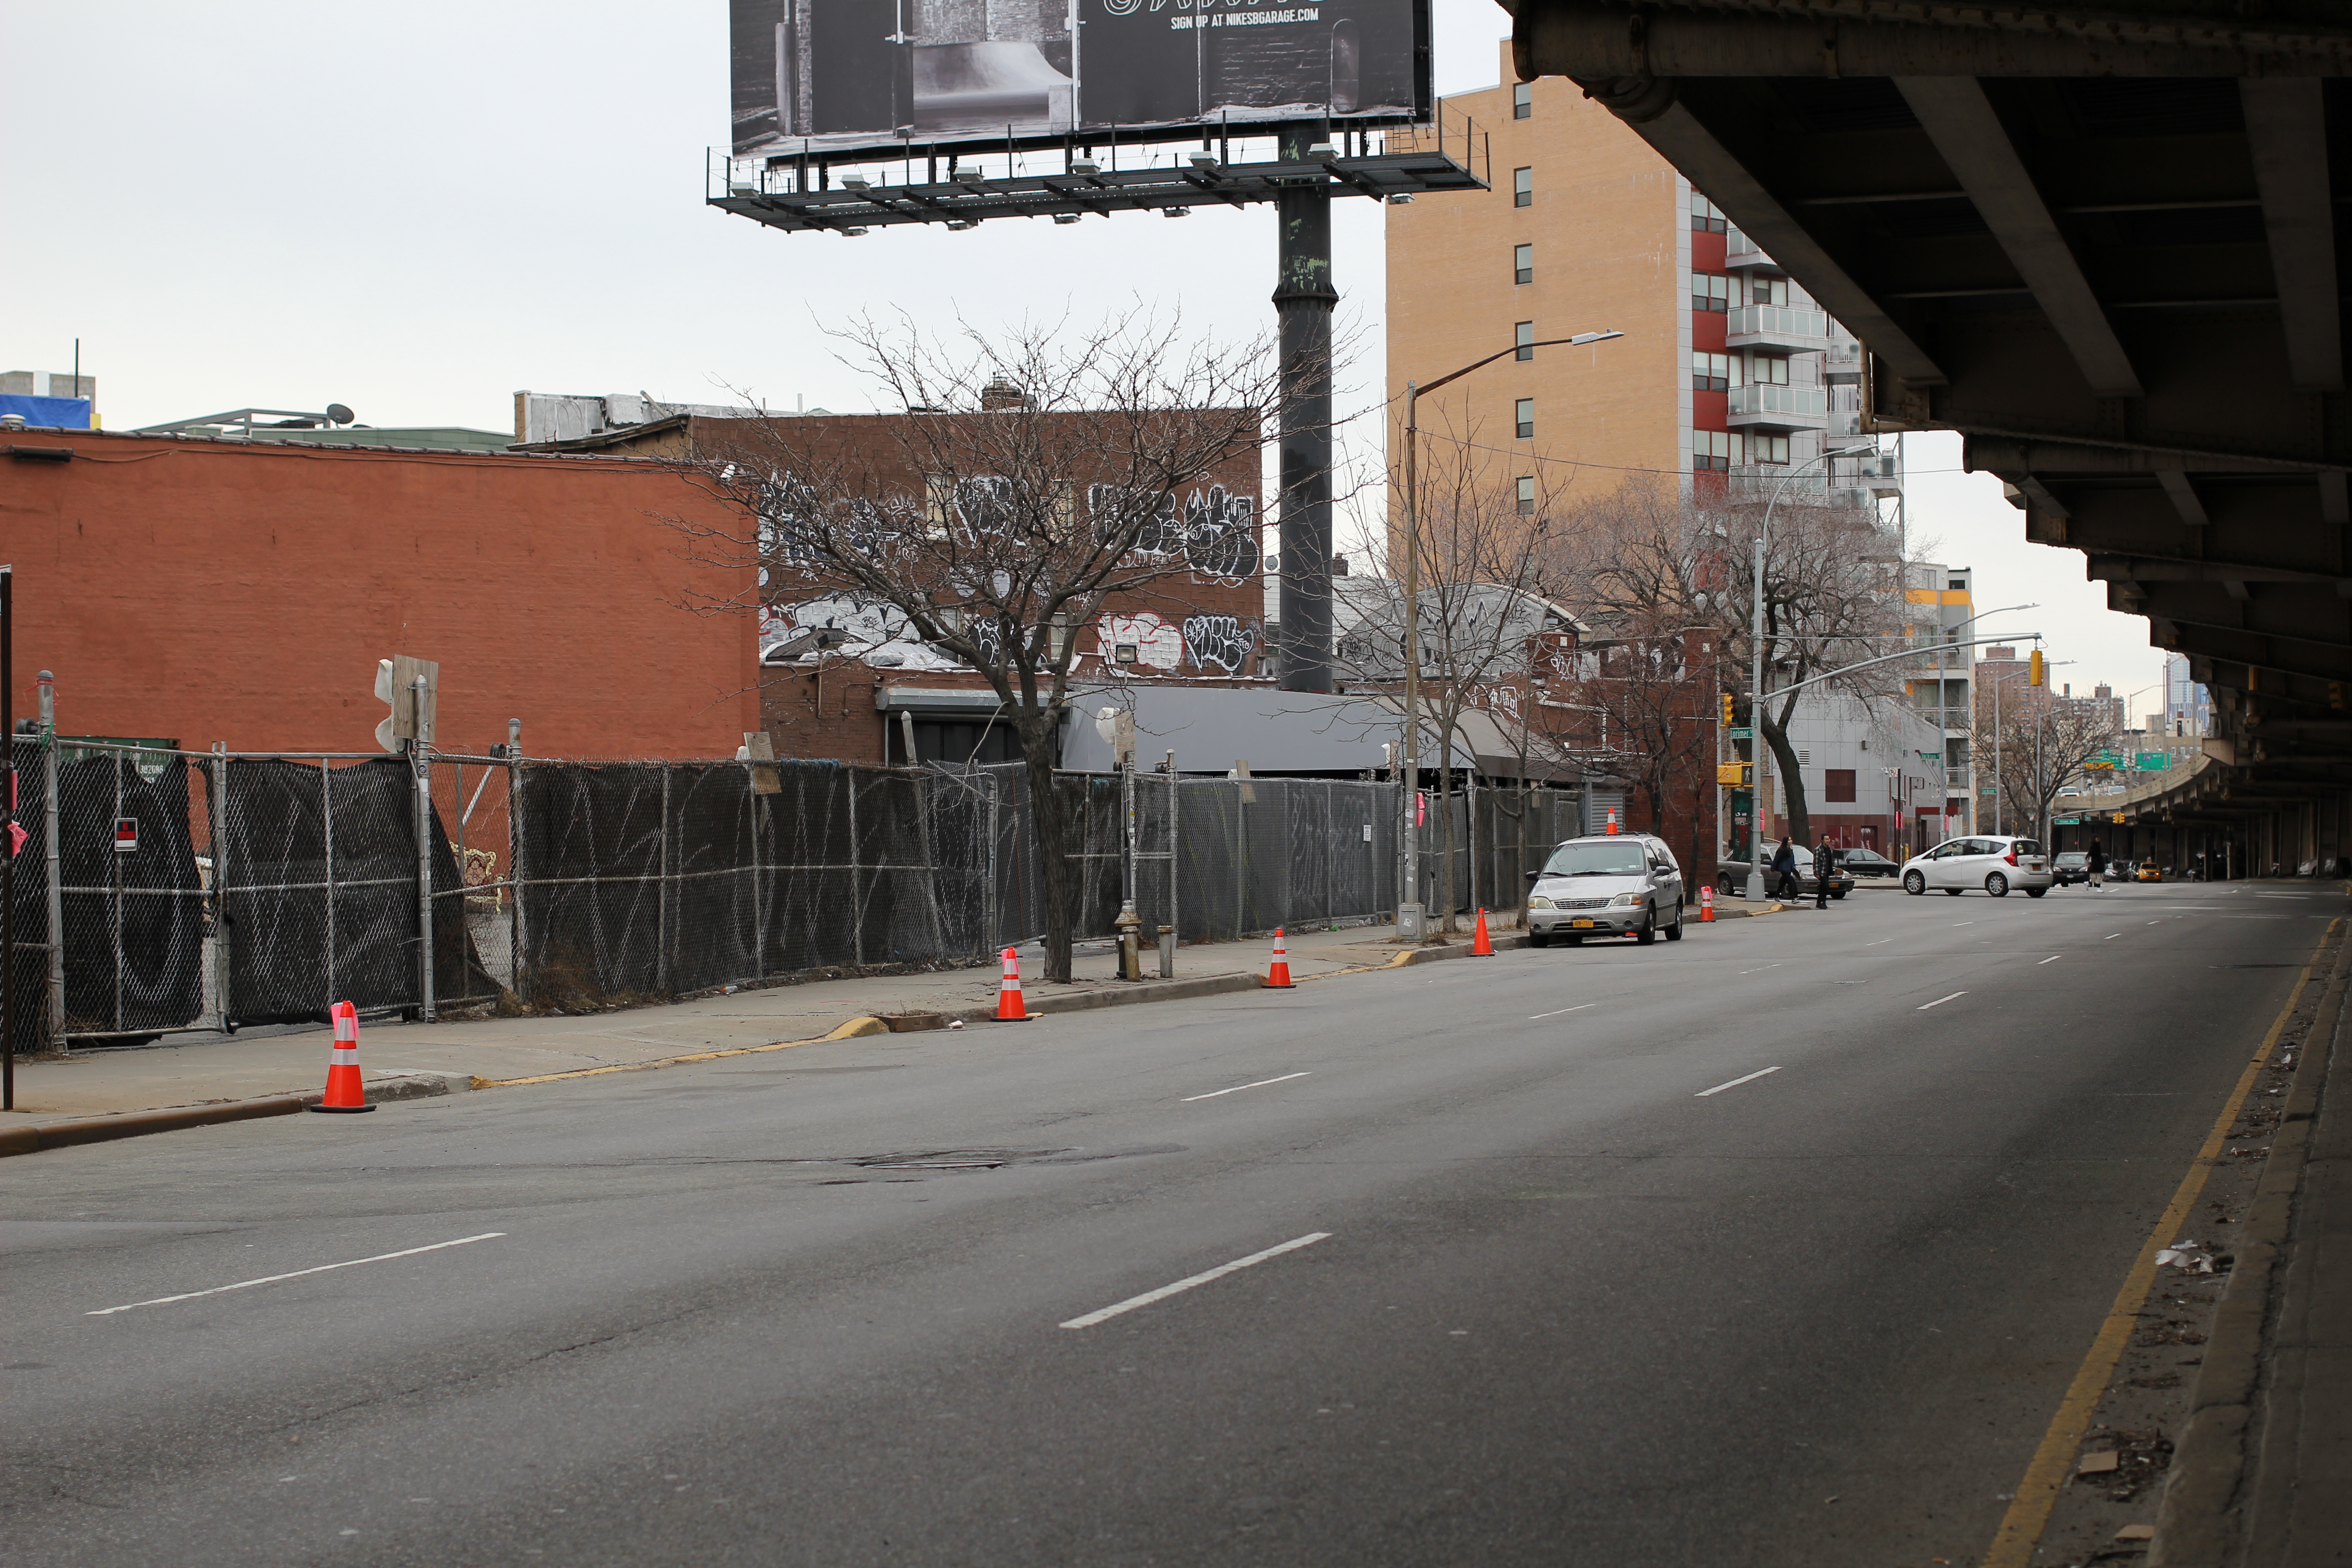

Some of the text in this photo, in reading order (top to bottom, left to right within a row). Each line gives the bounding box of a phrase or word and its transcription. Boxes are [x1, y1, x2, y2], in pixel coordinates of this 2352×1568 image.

[1171, 8, 1319, 30] SIGN UP AT NIKESBGARAGE.COM
[1730, 729, 1749, 738] Lorimer
